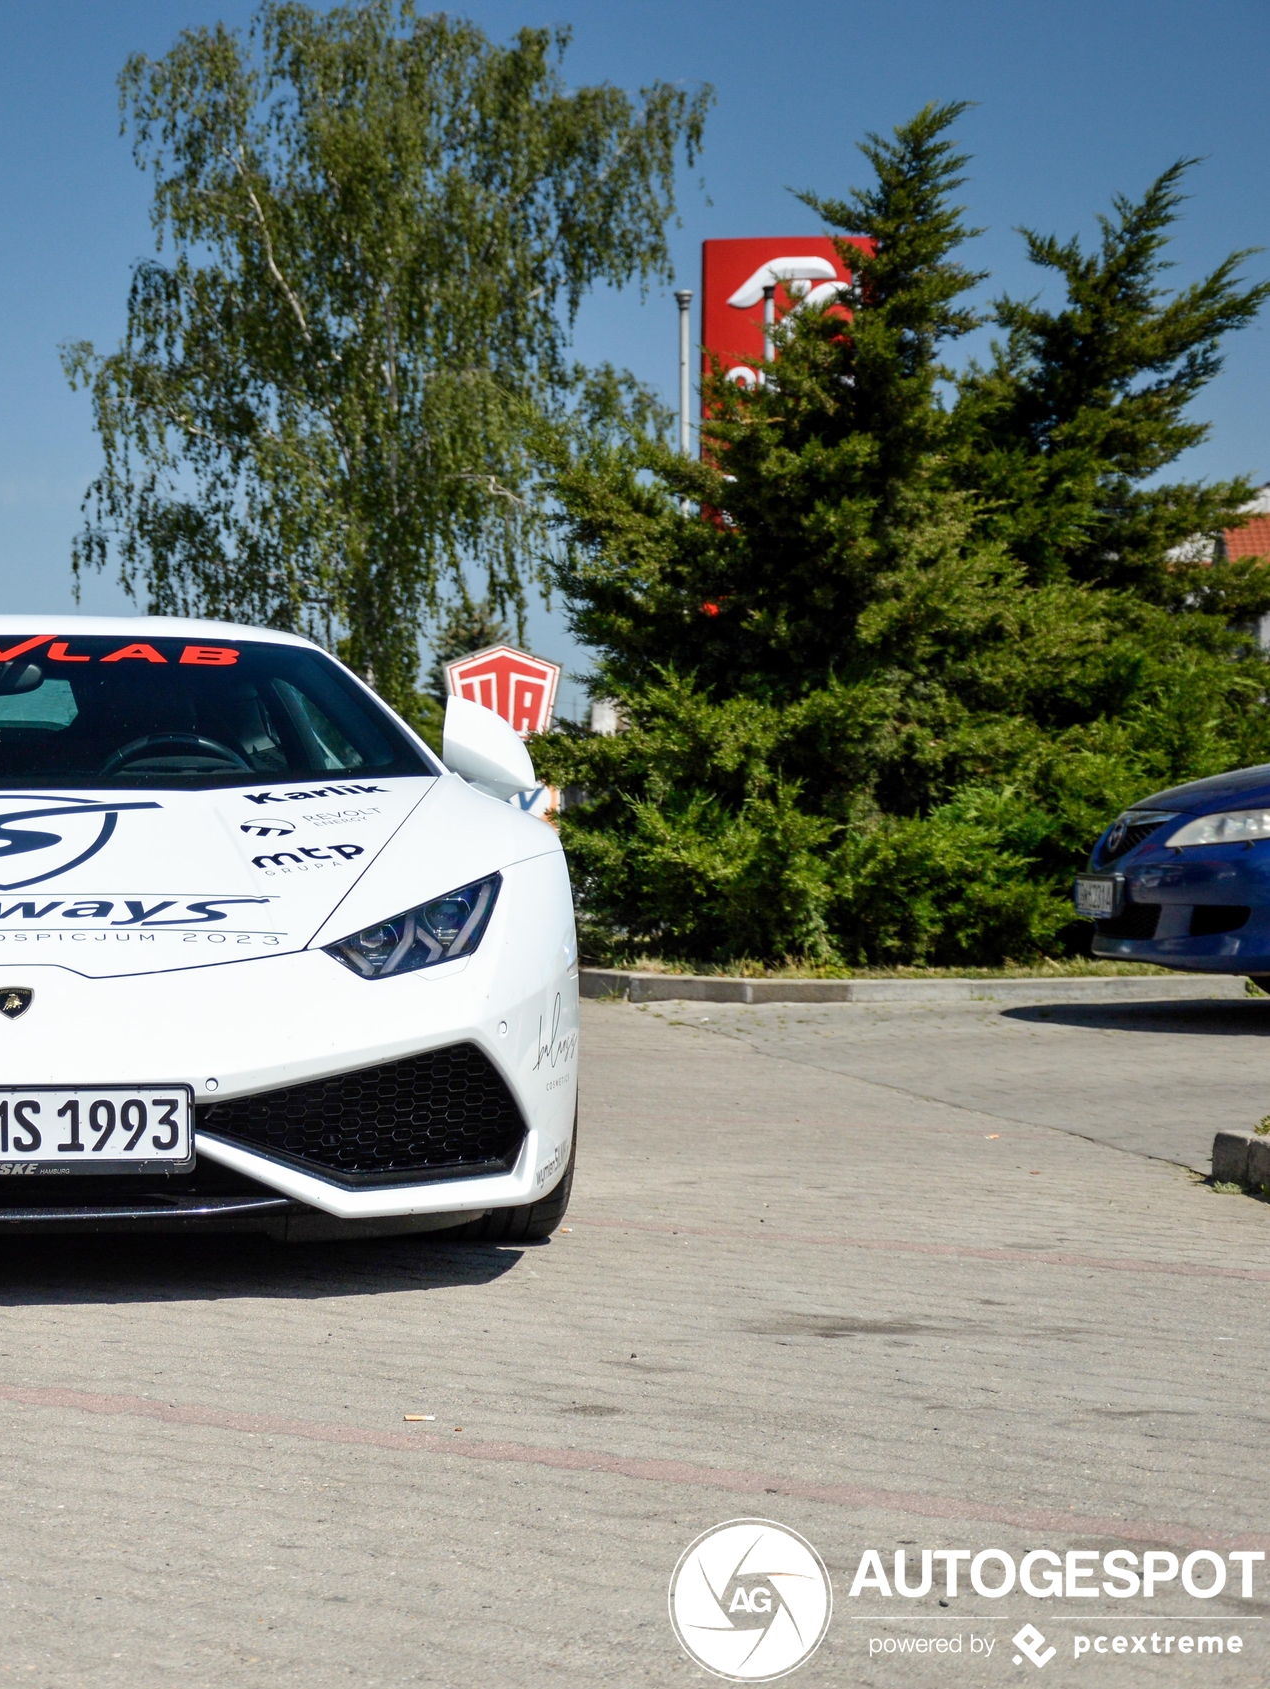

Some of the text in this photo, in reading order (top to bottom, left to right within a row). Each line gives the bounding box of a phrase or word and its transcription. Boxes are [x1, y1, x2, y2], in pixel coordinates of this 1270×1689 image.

[242, 785, 392, 804] Karlik
[302, 807, 381, 821] REVOLT
[313, 816, 367, 827] ENERGY
[251, 844, 365, 868] mtp
[265, 861, 342, 876] GRUPA
[183, 933, 280, 945] 2023
[546, 1073, 570, 1091] COSMETICS
[57, 1098, 179, 1152] 1993
